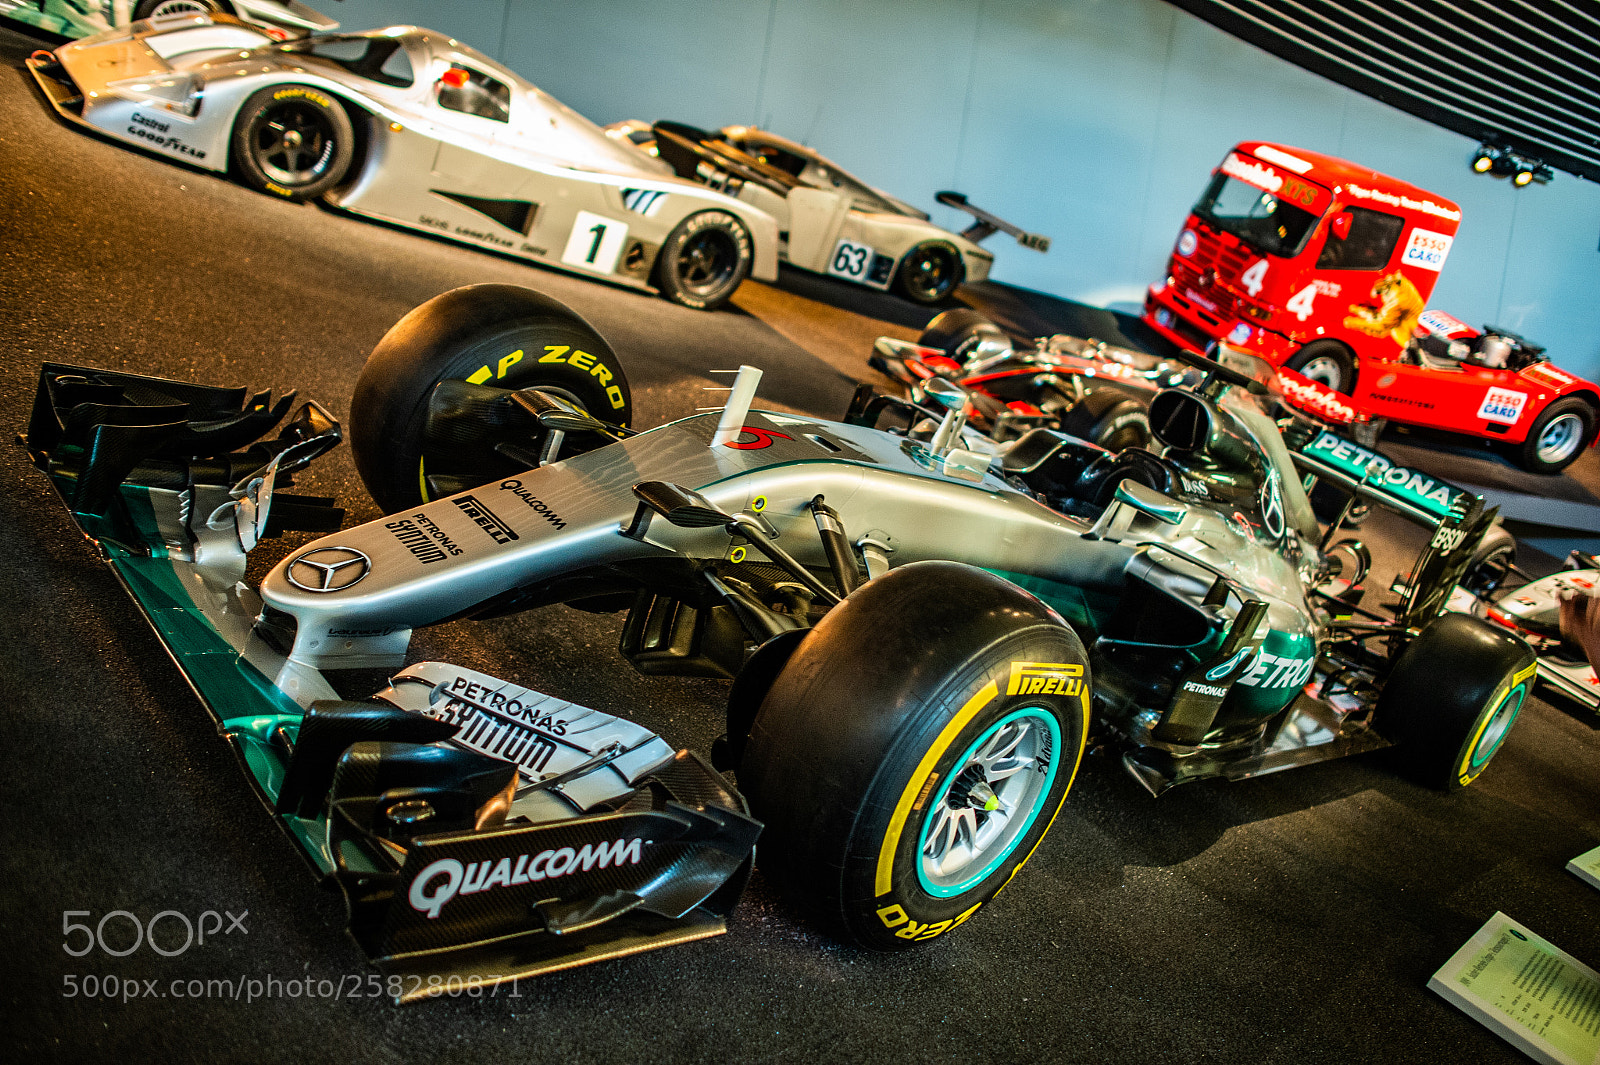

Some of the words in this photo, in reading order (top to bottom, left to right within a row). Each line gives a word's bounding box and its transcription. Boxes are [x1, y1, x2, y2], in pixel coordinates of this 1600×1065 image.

[127, 125, 206, 159] GOODYEAR
[584, 224, 607, 264] 1
[834, 243, 868, 277] 63
[1413, 235, 1446, 251] ESSO
[1241, 258, 1270, 297] 4
[1286, 283, 1318, 322] 4
[497, 349, 524, 379] P
[538, 345, 625, 411] ZERO
[1483, 404, 1516, 418] CARD
[1489, 393, 1521, 406] ESSO
[451, 494, 520, 545] PIRELLI
[499, 479, 567, 532] QUALCOMM
[412, 512, 464, 556] PETRONAS
[1006, 661, 1084, 697] PIRELLI
[1236, 645, 1314, 689] ETRO
[450, 676, 569, 736] PETRONAS
[1183, 680, 1228, 698] PETRONAS
[408, 837, 643, 919] QUALCOMM
